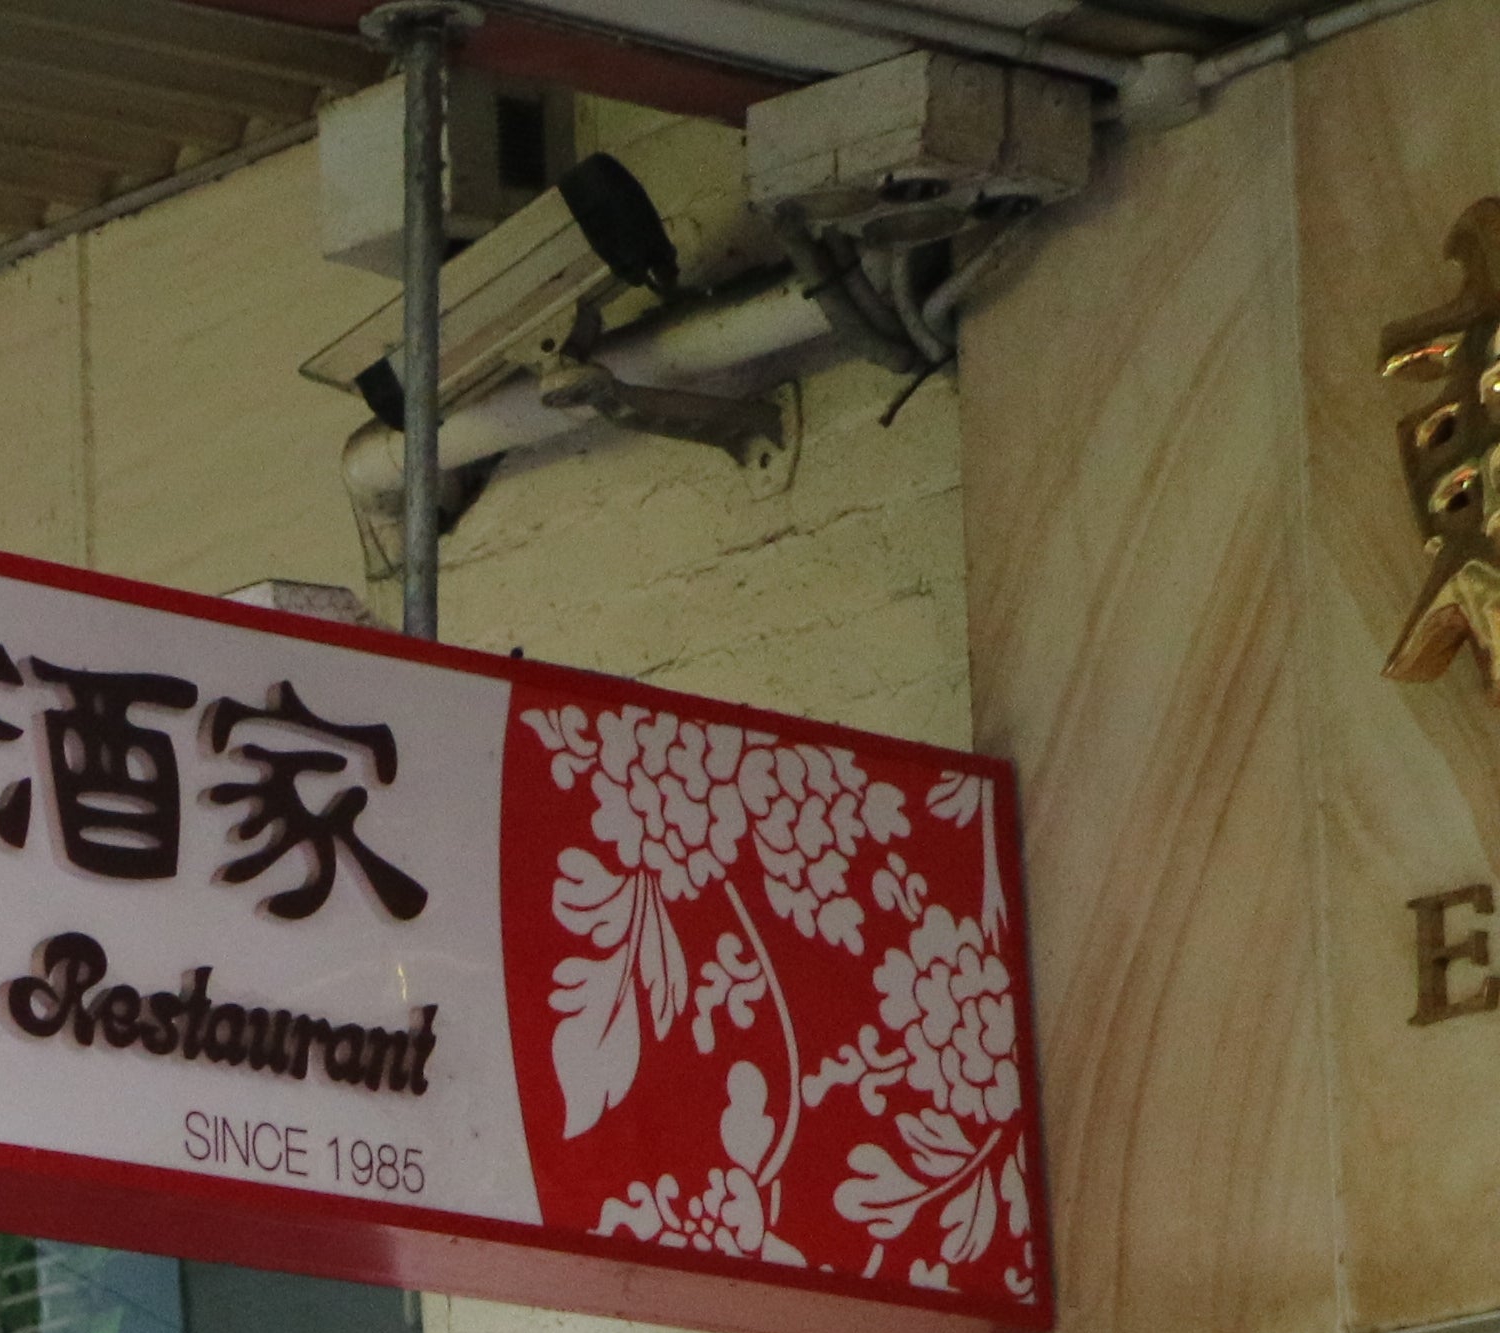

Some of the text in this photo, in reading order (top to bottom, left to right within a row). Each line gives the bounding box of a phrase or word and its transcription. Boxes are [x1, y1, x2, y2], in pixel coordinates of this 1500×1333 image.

[3, 932, 438, 1095] Restaurant
[183, 1110, 424, 1195] SINCE 1985
